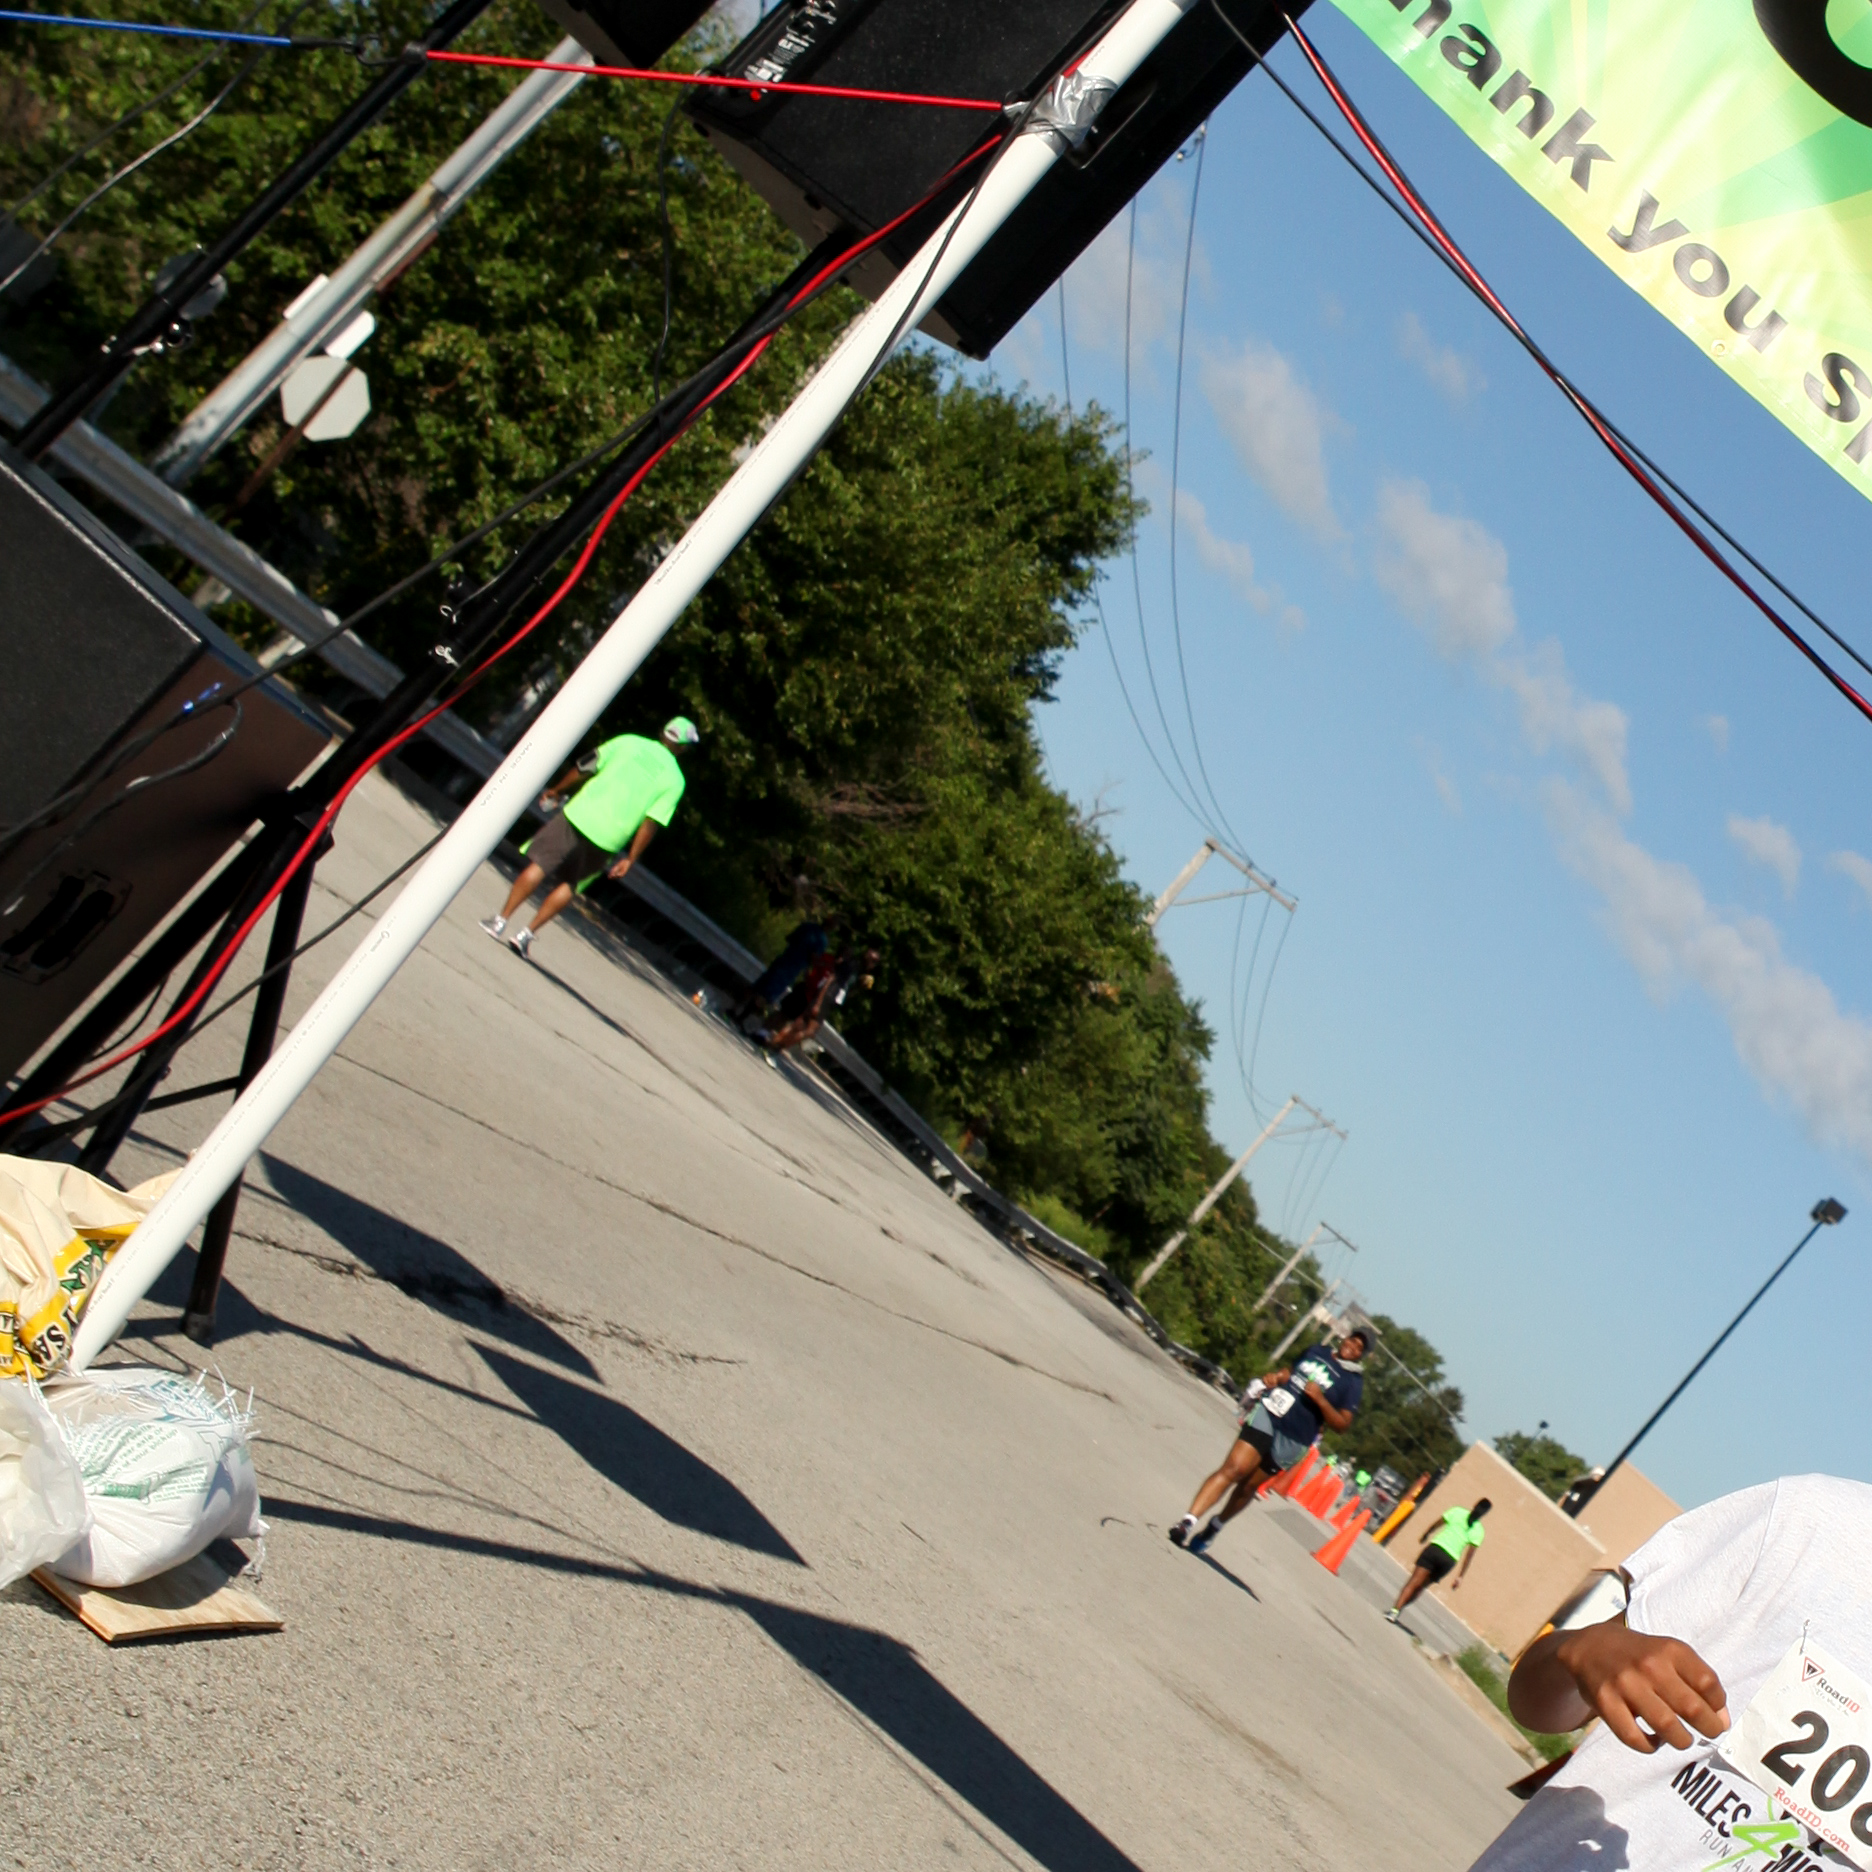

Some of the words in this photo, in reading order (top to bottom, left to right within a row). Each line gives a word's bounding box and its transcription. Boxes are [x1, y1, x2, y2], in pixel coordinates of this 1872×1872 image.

[1607, 193, 1789, 354] you
[1817, 1677, 1861, 1713] RoadID
[1671, 1761, 1752, 1838] MILES
[1773, 1786, 1850, 1853] RoadID.com
[1699, 1829, 1734, 1859] RUN
